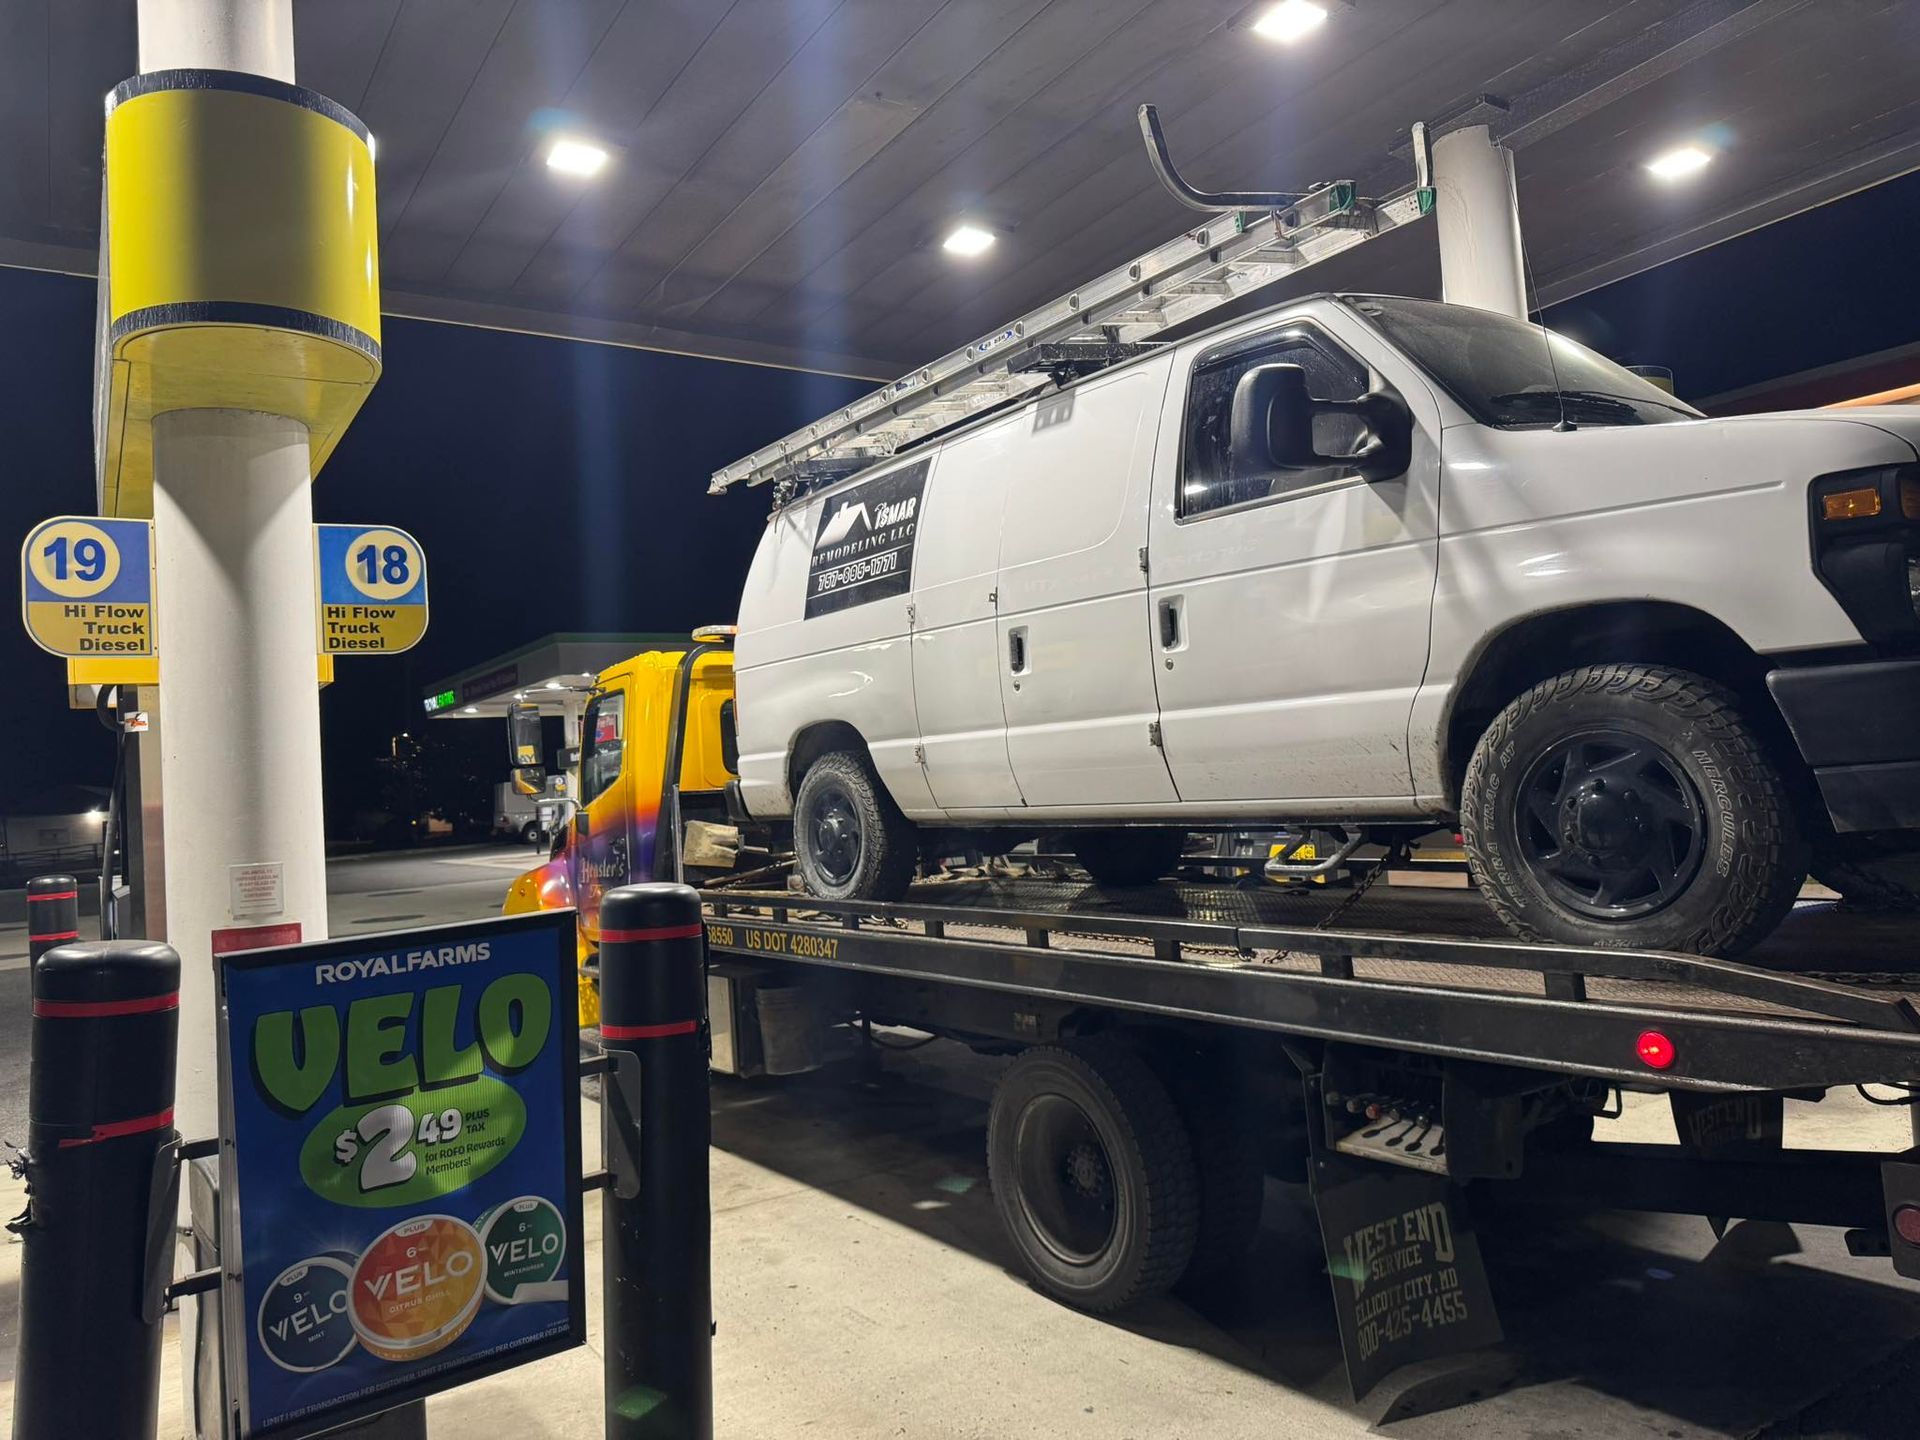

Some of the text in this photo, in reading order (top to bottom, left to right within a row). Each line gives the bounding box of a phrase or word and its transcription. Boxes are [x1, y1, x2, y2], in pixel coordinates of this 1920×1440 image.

[812, 523, 915, 568] REMODELING LLC
[43, 536, 107, 582] 19
[356, 544, 410, 585] 18
[64, 605, 145, 618] Hi Flow
[327, 606, 396, 619] Hi Flow
[83, 622, 145, 635] Truck
[327, 622, 381, 634] Truck
[79, 638, 145, 652] Diesel
[328, 637, 385, 649] Diesel
[1484, 773, 1501, 831] TRAC
[1692, 750, 1735, 878] HERCULES
[745, 929, 839, 959] US DOT 4280347
[254, 972, 551, 1112] VELO
[465, 1108, 490, 1122] PLUS
[466, 1122, 485, 1134] TAX
[425, 1136, 506, 1163] for ROFO Rewards
[426, 1156, 472, 1176] Members!
[403, 1222, 426, 1234] PLUS
[518, 1222, 527, 1232] 6
[406, 1246, 417, 1258] 6
[489, 1233, 559, 1267] VELO
[1343, 1201, 1456, 1301] WEST END
[1371, 1243, 1423, 1281] SERVICE
[286, 1270, 304, 1283] PLUS
[363, 1250, 474, 1301] VELO
[293, 1292, 303, 1304] 9
[389, 1298, 423, 1313] CITRUS
[1354, 1283, 1403, 1327] ELLICOTT
[1438, 1266, 1458, 1291] MD
[268, 1289, 347, 1342] VELO
[1357, 1289, 1468, 1362] 800-425-4455
[308, 1330, 326, 1342] MINT
[306, 1390, 360, 1415] TRANSACTION
